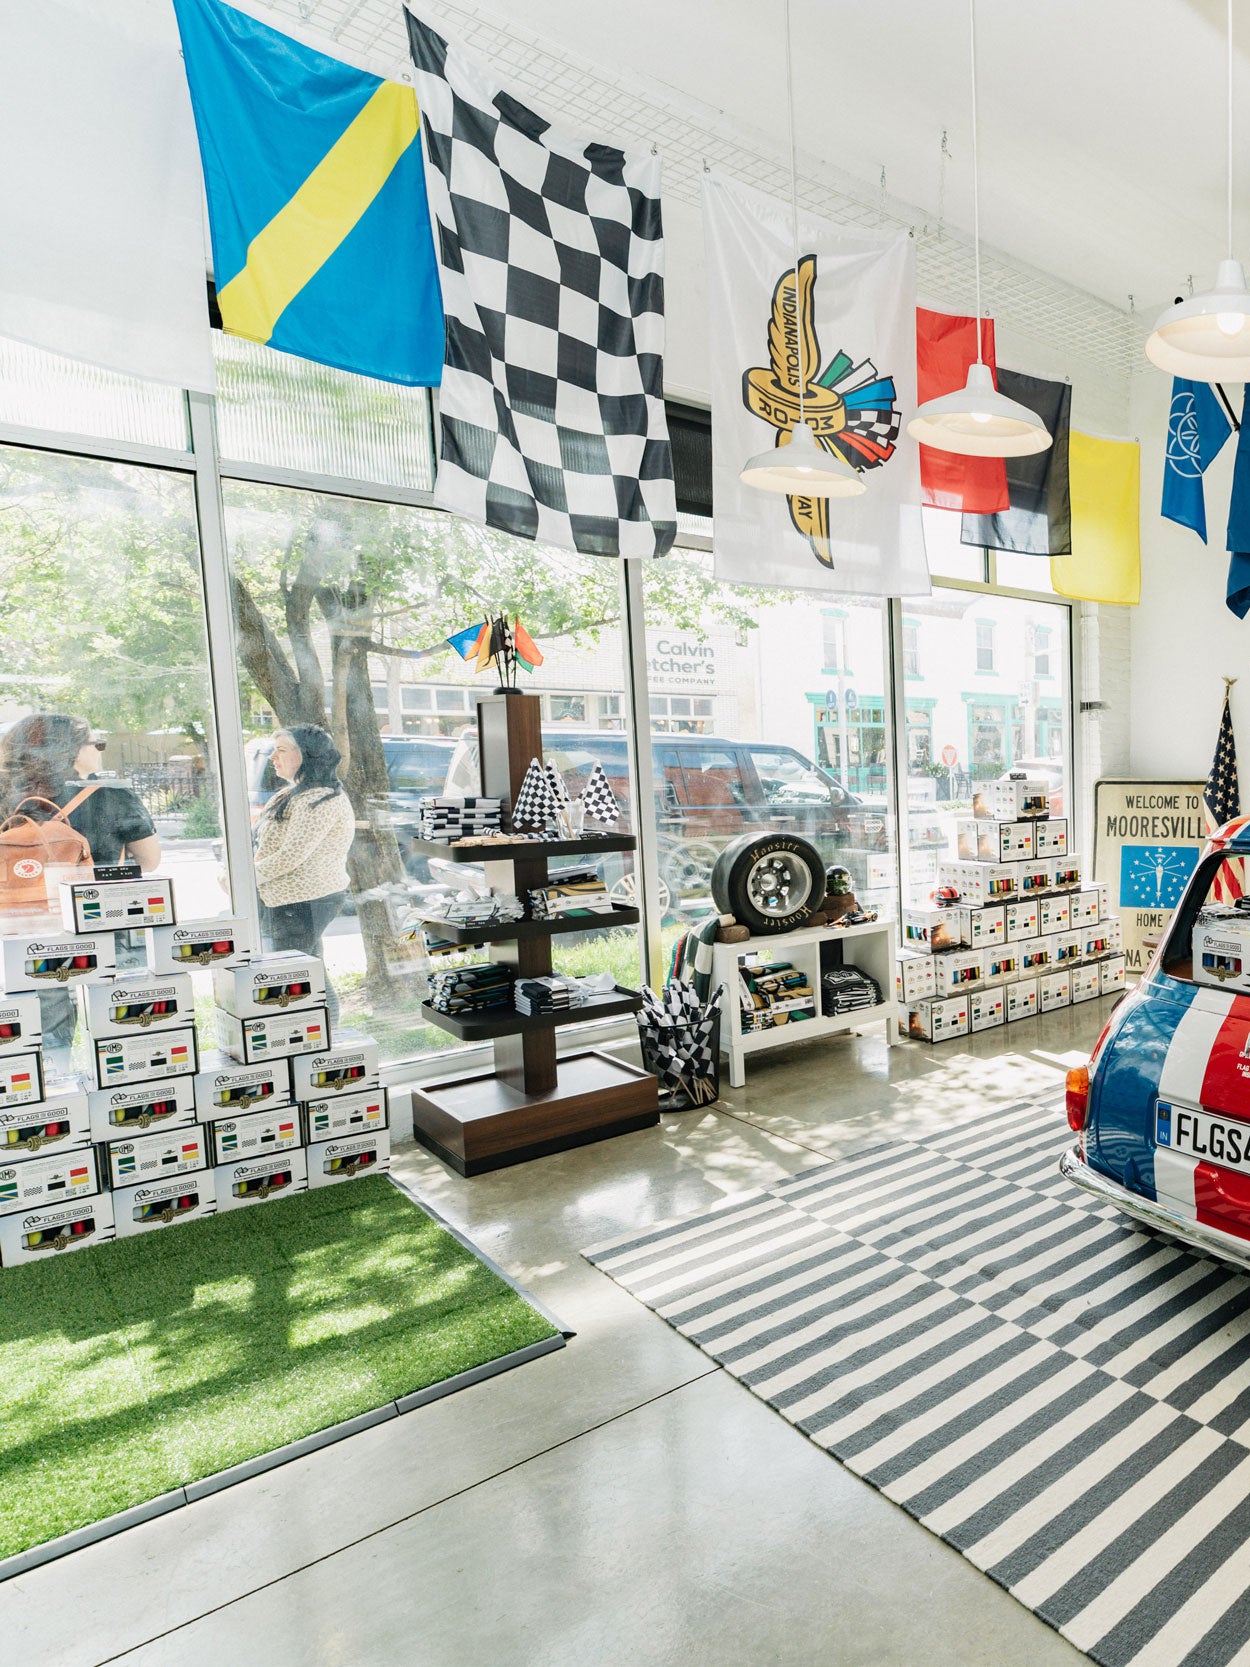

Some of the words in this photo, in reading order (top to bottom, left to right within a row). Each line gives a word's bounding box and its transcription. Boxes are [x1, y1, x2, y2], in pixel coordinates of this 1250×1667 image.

[782, 285, 799, 388] INDIANAPOLIS
[656, 640, 715, 658] Calvin
[646, 658, 715, 675] tcher's
[669, 677, 715, 685] COMPANY
[1126, 795, 1180, 809] WELCOME
[1185, 795, 1199, 808] TO
[1106, 815, 1206, 839] MOORESVILL
[750, 841, 800, 862] Hoosier
[763, 904, 813, 927] Hoosier
[1136, 913, 1163, 928] HOME
[1236, 1063, 1250, 1072] FLAG
[1160, 1131, 1168, 1141] IN
